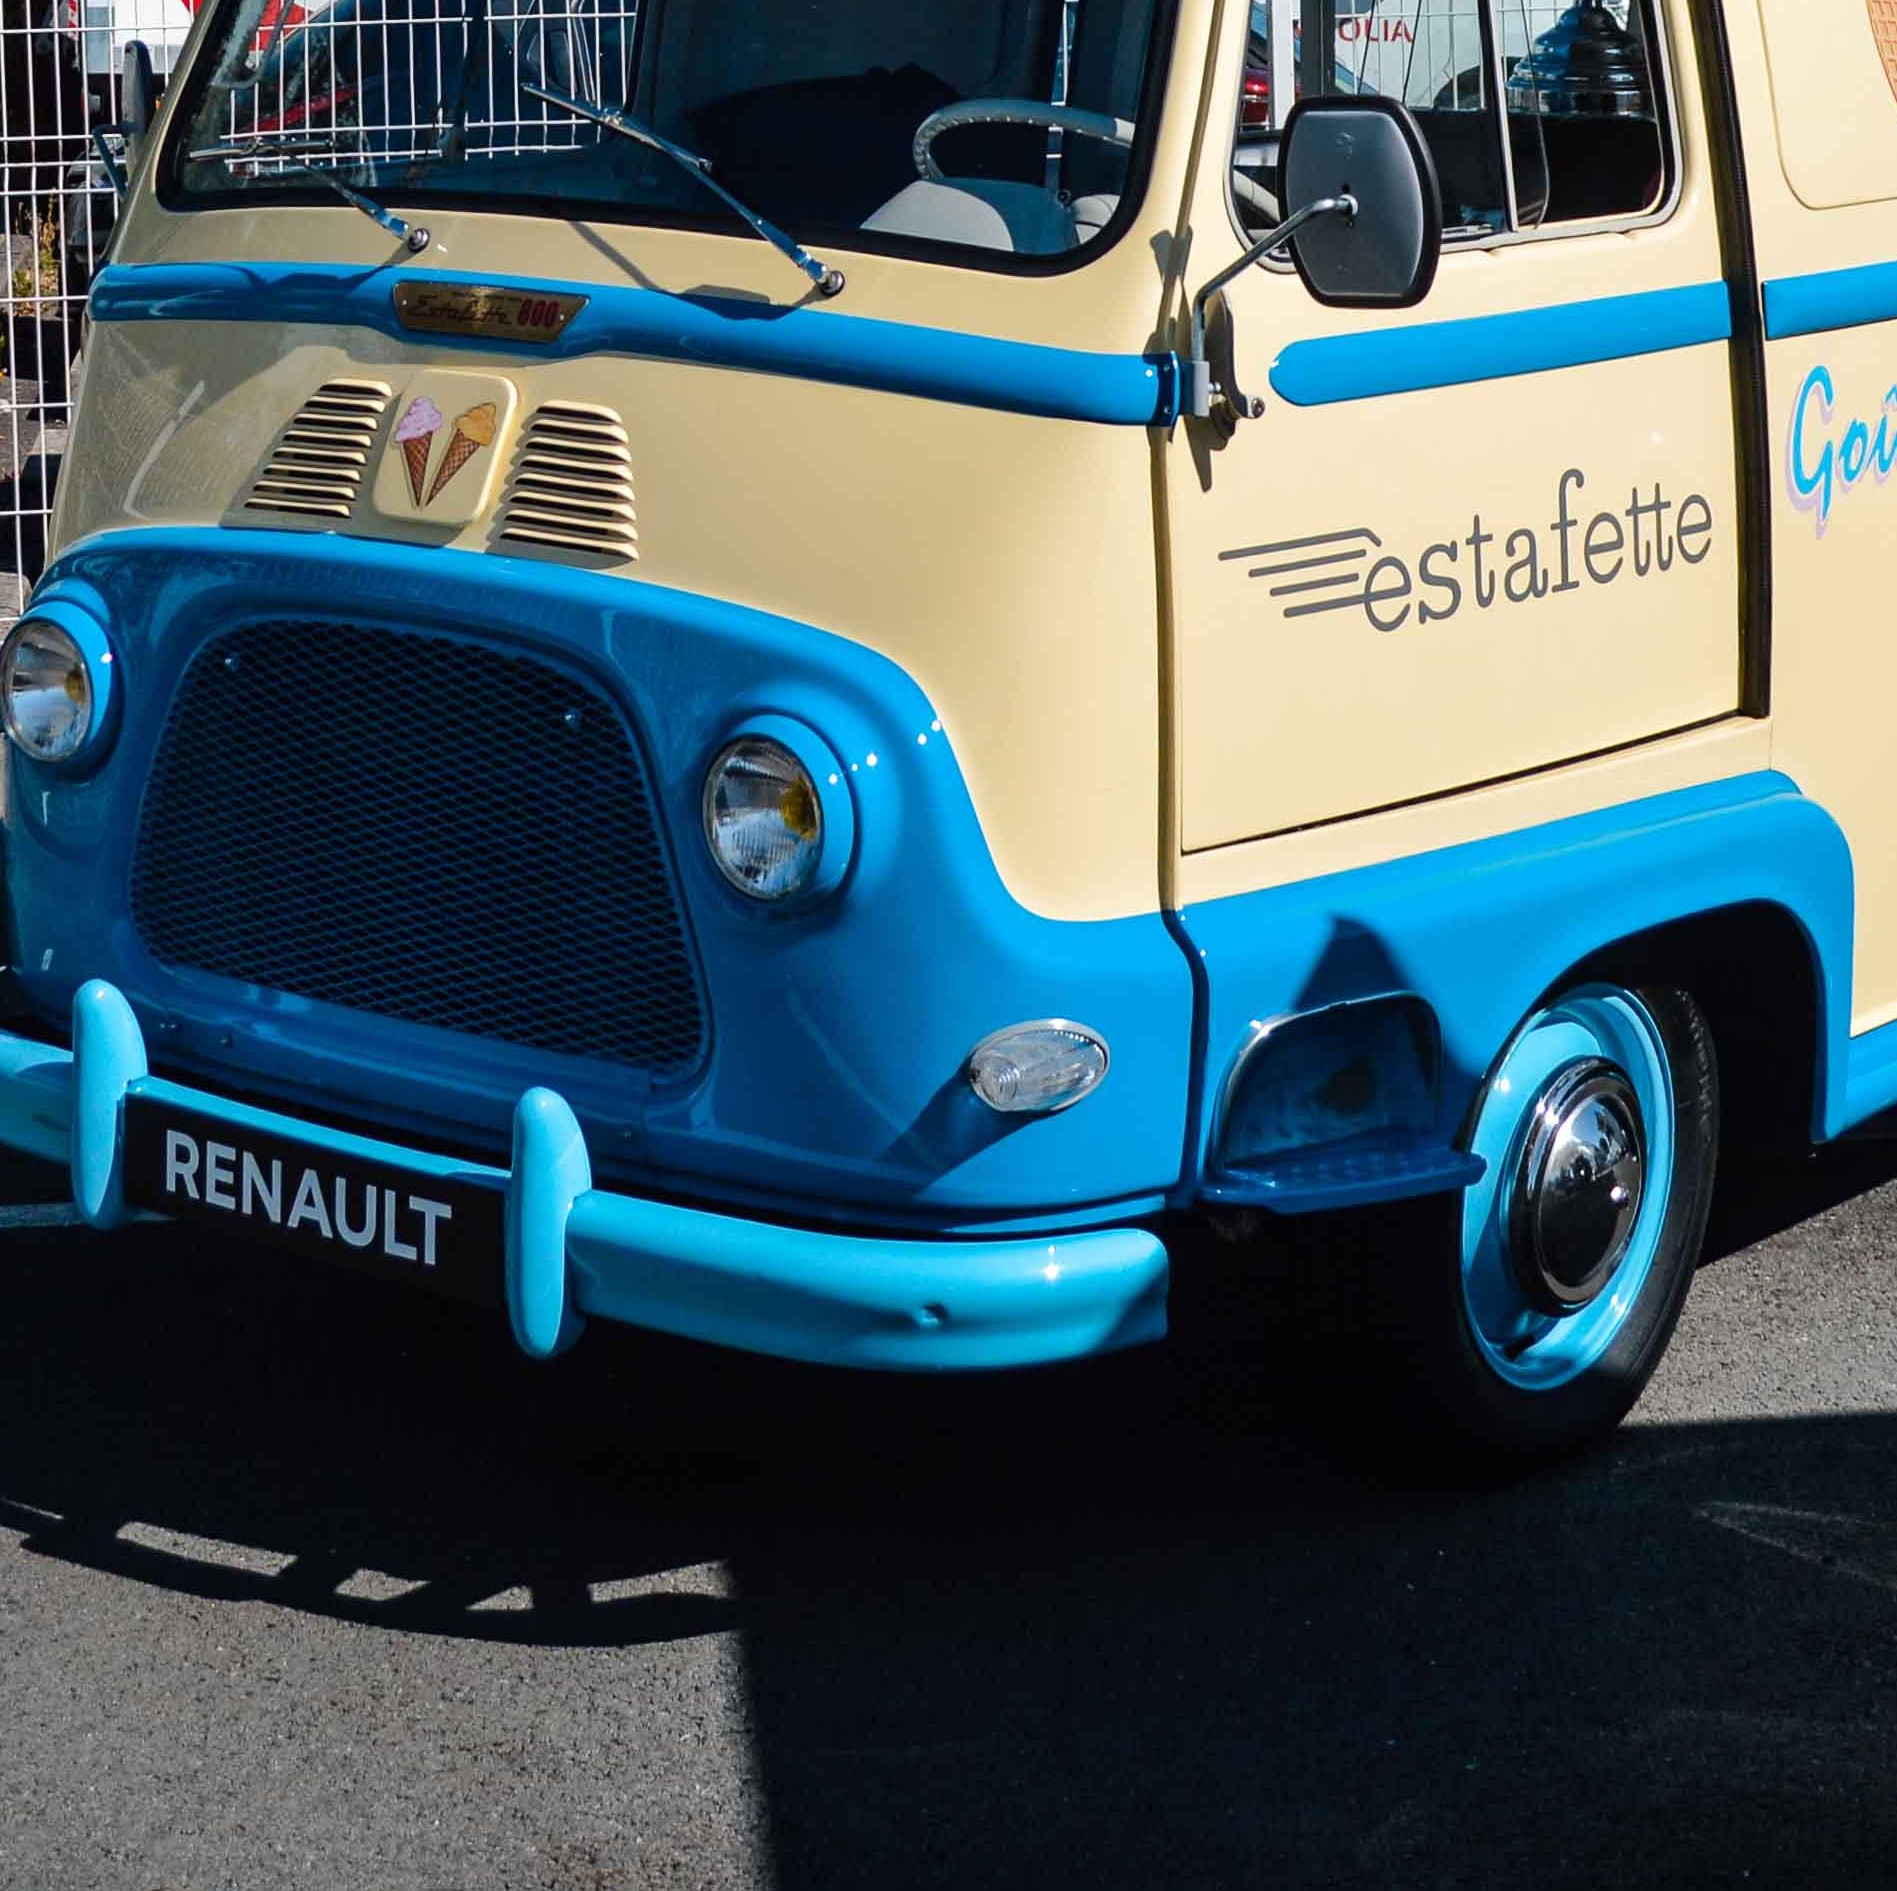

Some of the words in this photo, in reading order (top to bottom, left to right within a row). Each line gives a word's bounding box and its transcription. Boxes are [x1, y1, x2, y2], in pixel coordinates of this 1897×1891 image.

[1337, 17, 1414, 43] OLIA
[1361, 468, 1714, 634] estafette
[165, 1129, 453, 1266] RENAULT
